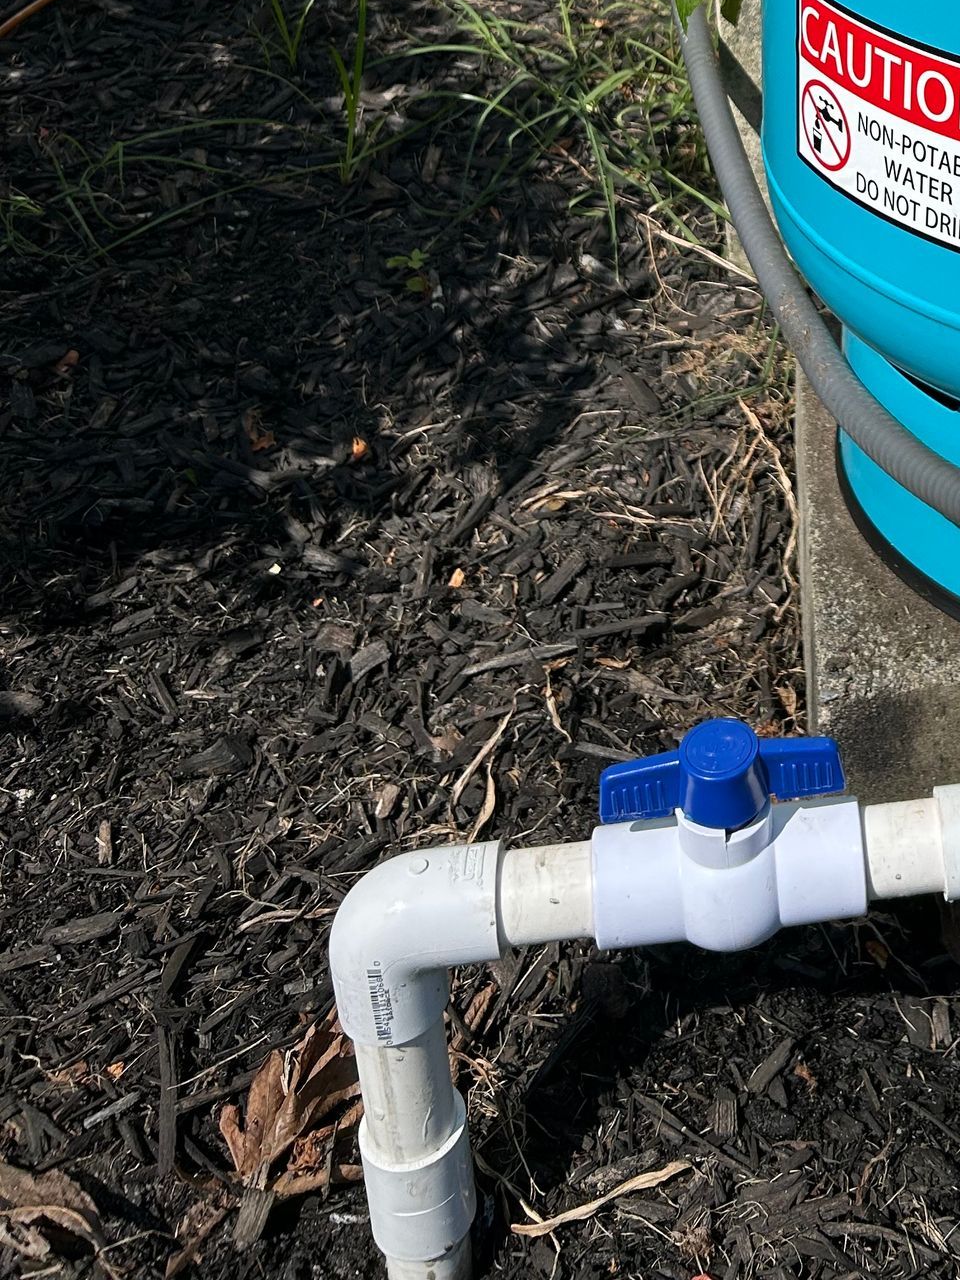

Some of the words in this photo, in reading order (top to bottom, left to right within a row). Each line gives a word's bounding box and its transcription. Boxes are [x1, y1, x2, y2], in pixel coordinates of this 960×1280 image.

[856, 171, 879, 201] DO
[884, 194, 920, 222] NOT
[884, 156, 953, 206] WATER
